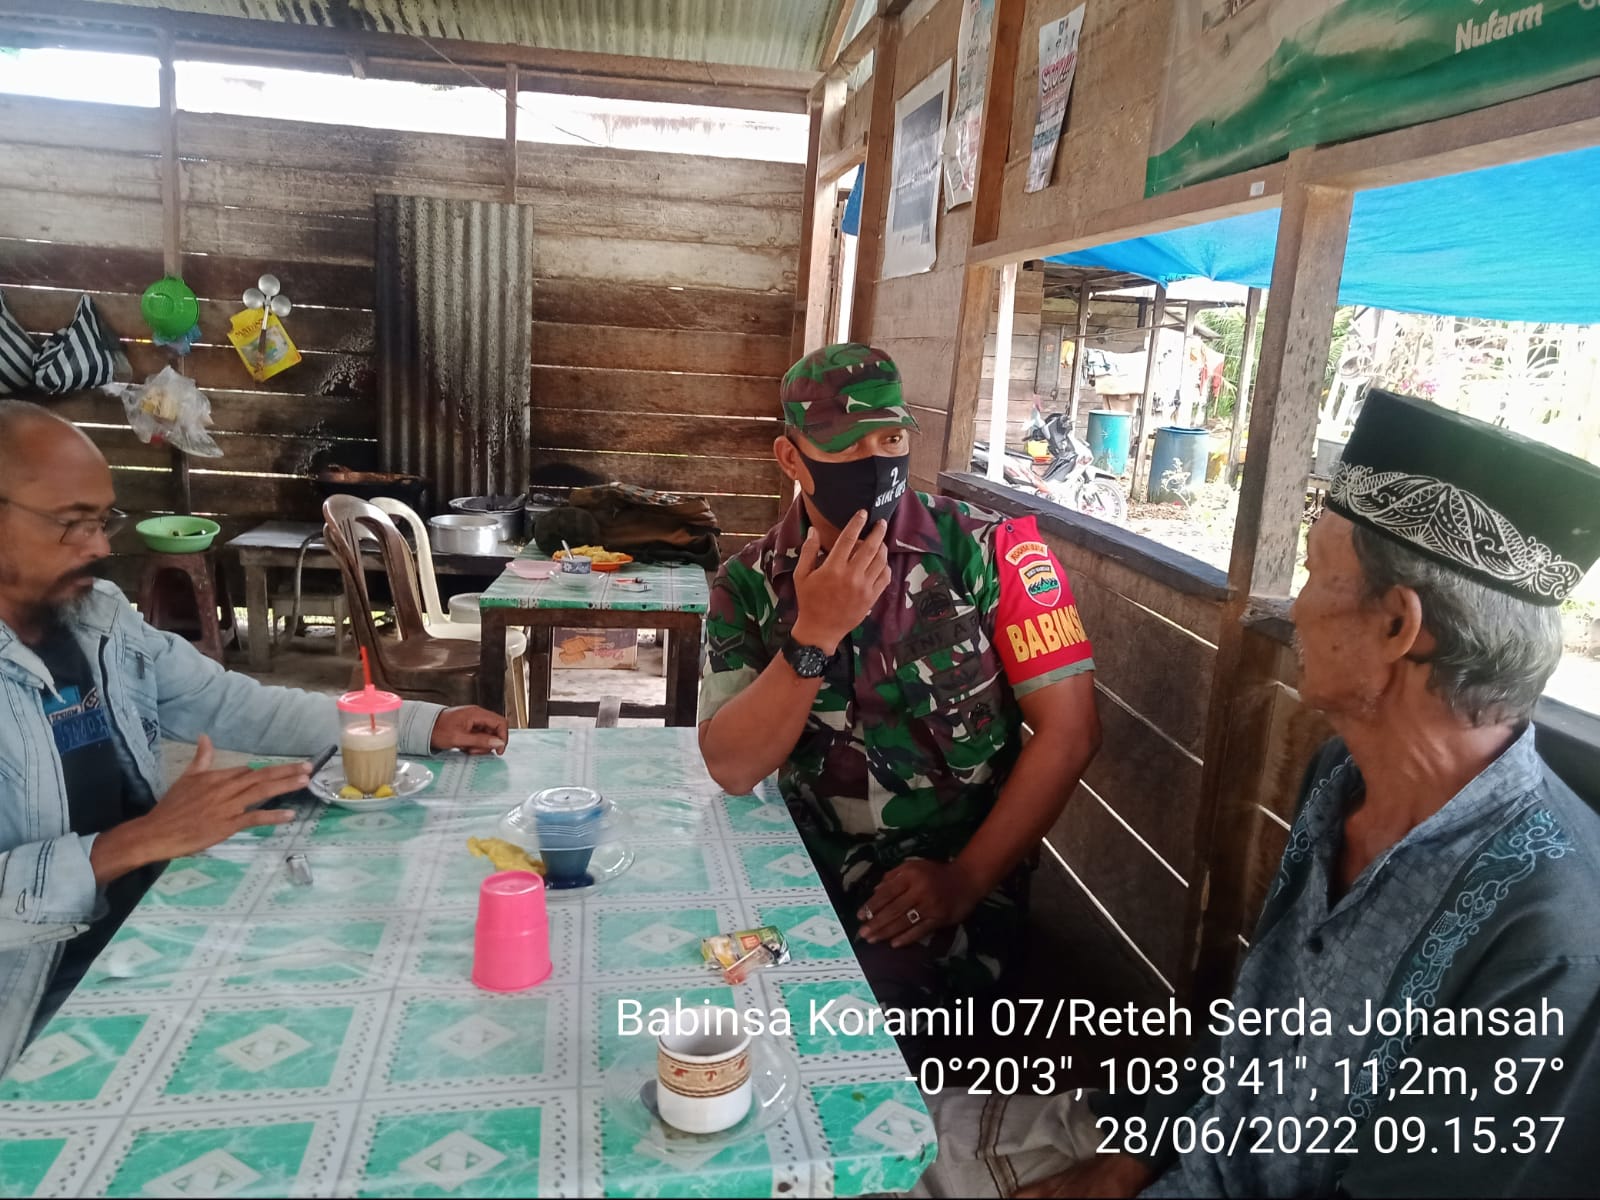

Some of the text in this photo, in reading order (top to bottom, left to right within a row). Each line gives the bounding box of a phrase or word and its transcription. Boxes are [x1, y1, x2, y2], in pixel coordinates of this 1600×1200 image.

[1455, 2, 1544, 54] Nufarm
[890, 466, 900, 488] 2
[1006, 604, 1089, 663] BABINS
